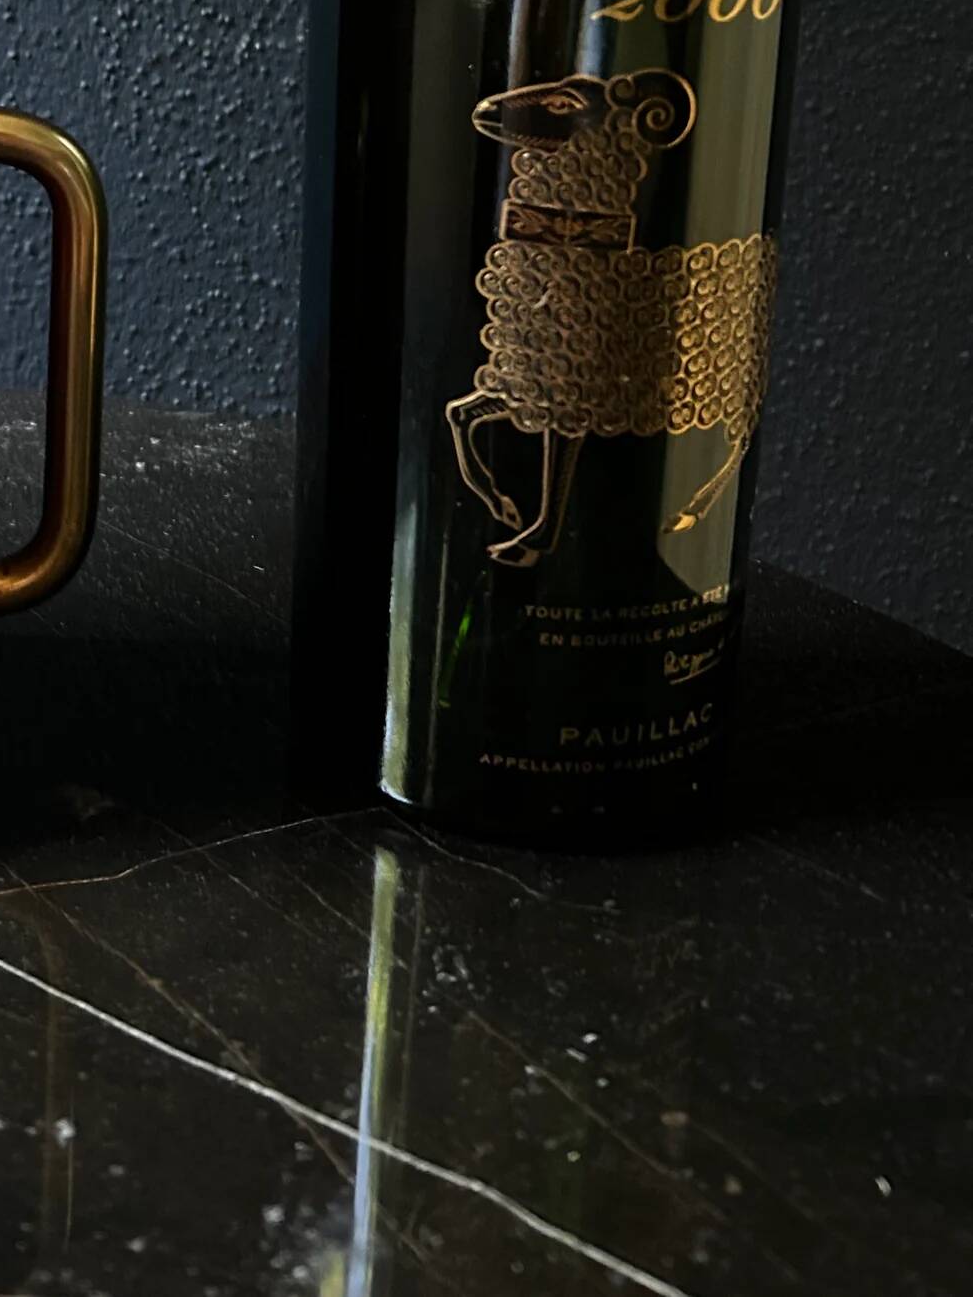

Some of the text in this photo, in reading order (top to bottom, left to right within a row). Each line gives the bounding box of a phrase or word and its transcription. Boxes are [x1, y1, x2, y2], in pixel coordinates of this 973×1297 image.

[525, 604, 584, 622] TOUTE
[591, 606, 613, 622] LA
[538, 631, 564, 647] EN
[570, 628, 663, 647] BOUTEILLE
[666, 622, 687, 639] AU
[559, 702, 713, 747] PAUILLAC
[478, 753, 606, 774] APPELLATION
